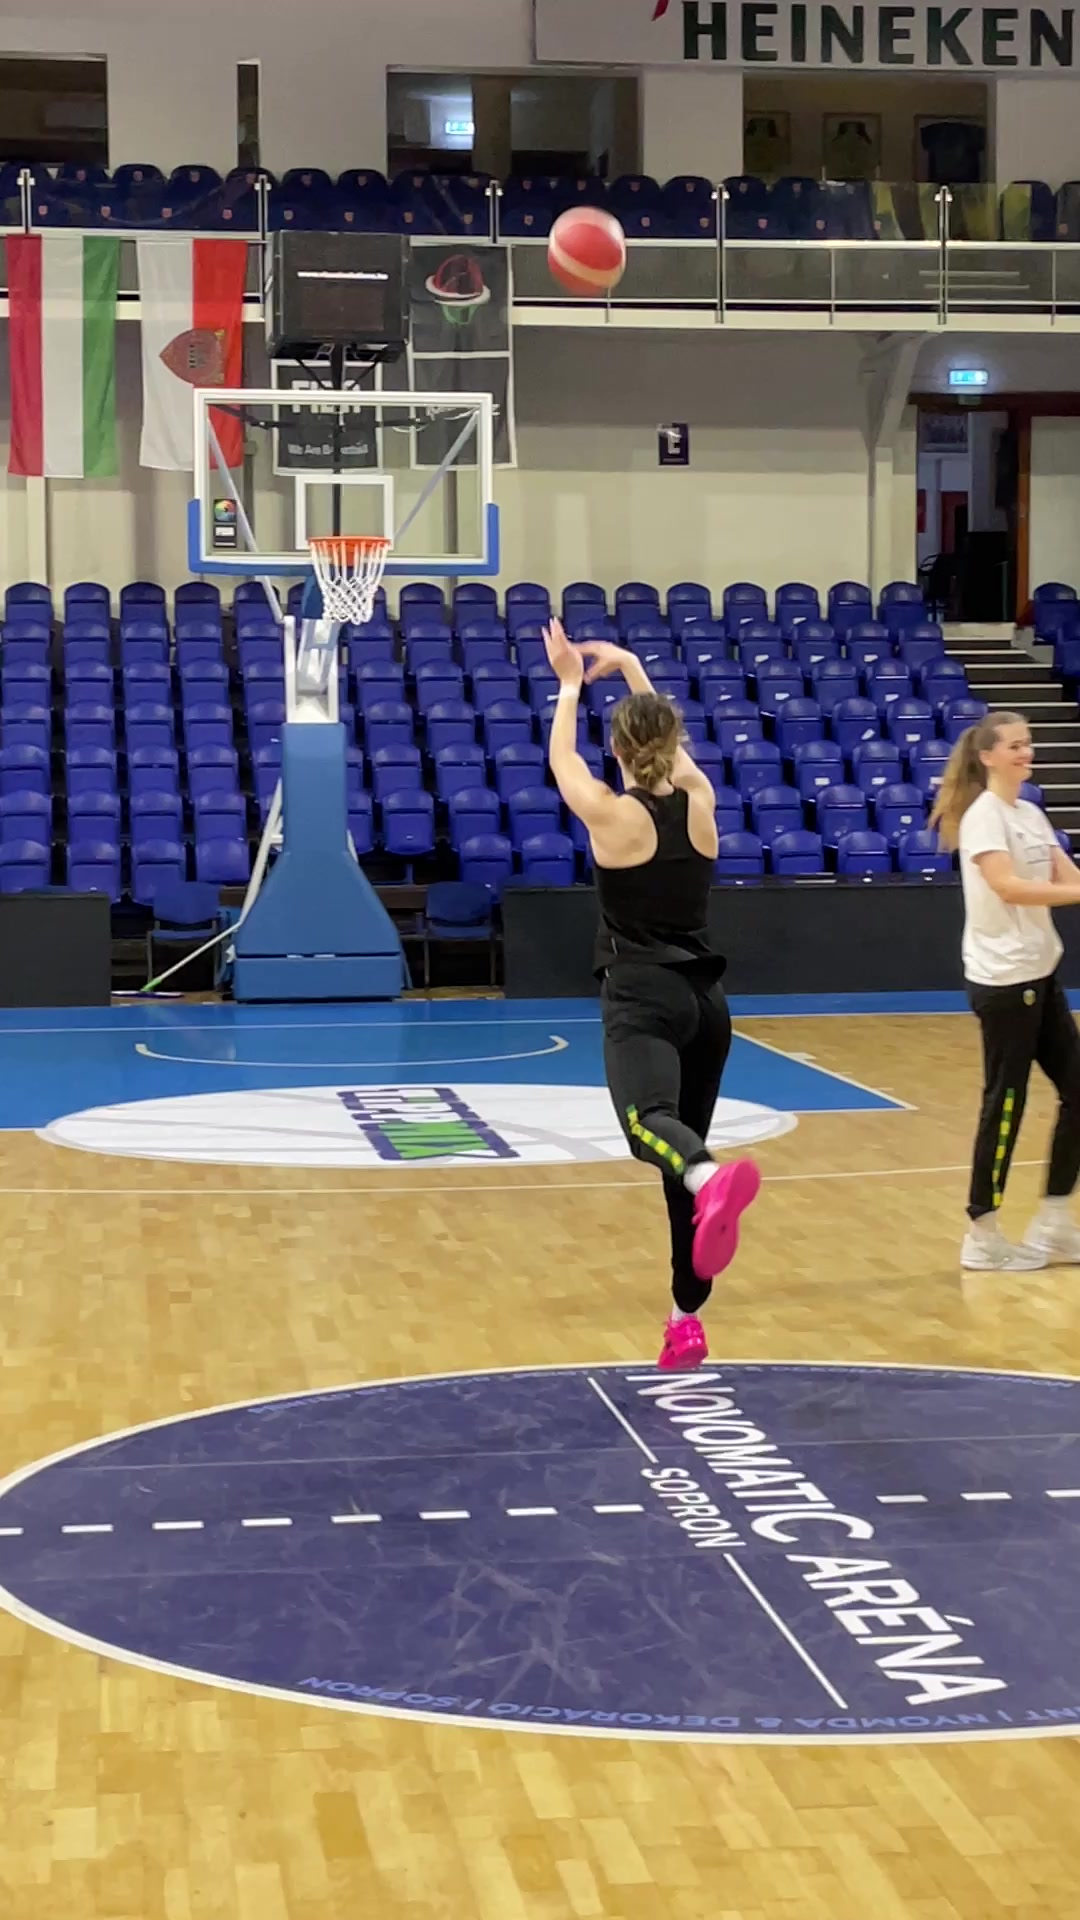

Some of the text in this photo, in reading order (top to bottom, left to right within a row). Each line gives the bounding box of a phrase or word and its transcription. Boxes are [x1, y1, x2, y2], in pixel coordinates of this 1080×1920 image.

[683, 1, 1075, 67] HEINEKEN
[641, 1467, 747, 1548] SOPRON
[625, 1372, 875, 1543] NOVOMATIC
[785, 1554, 1008, 1705] ARÉNA
[300, 1676, 453, 1709] SOPRON
[755, 1717, 783, 1729] &
[794, 1711, 989, 1728] NYOMDA
